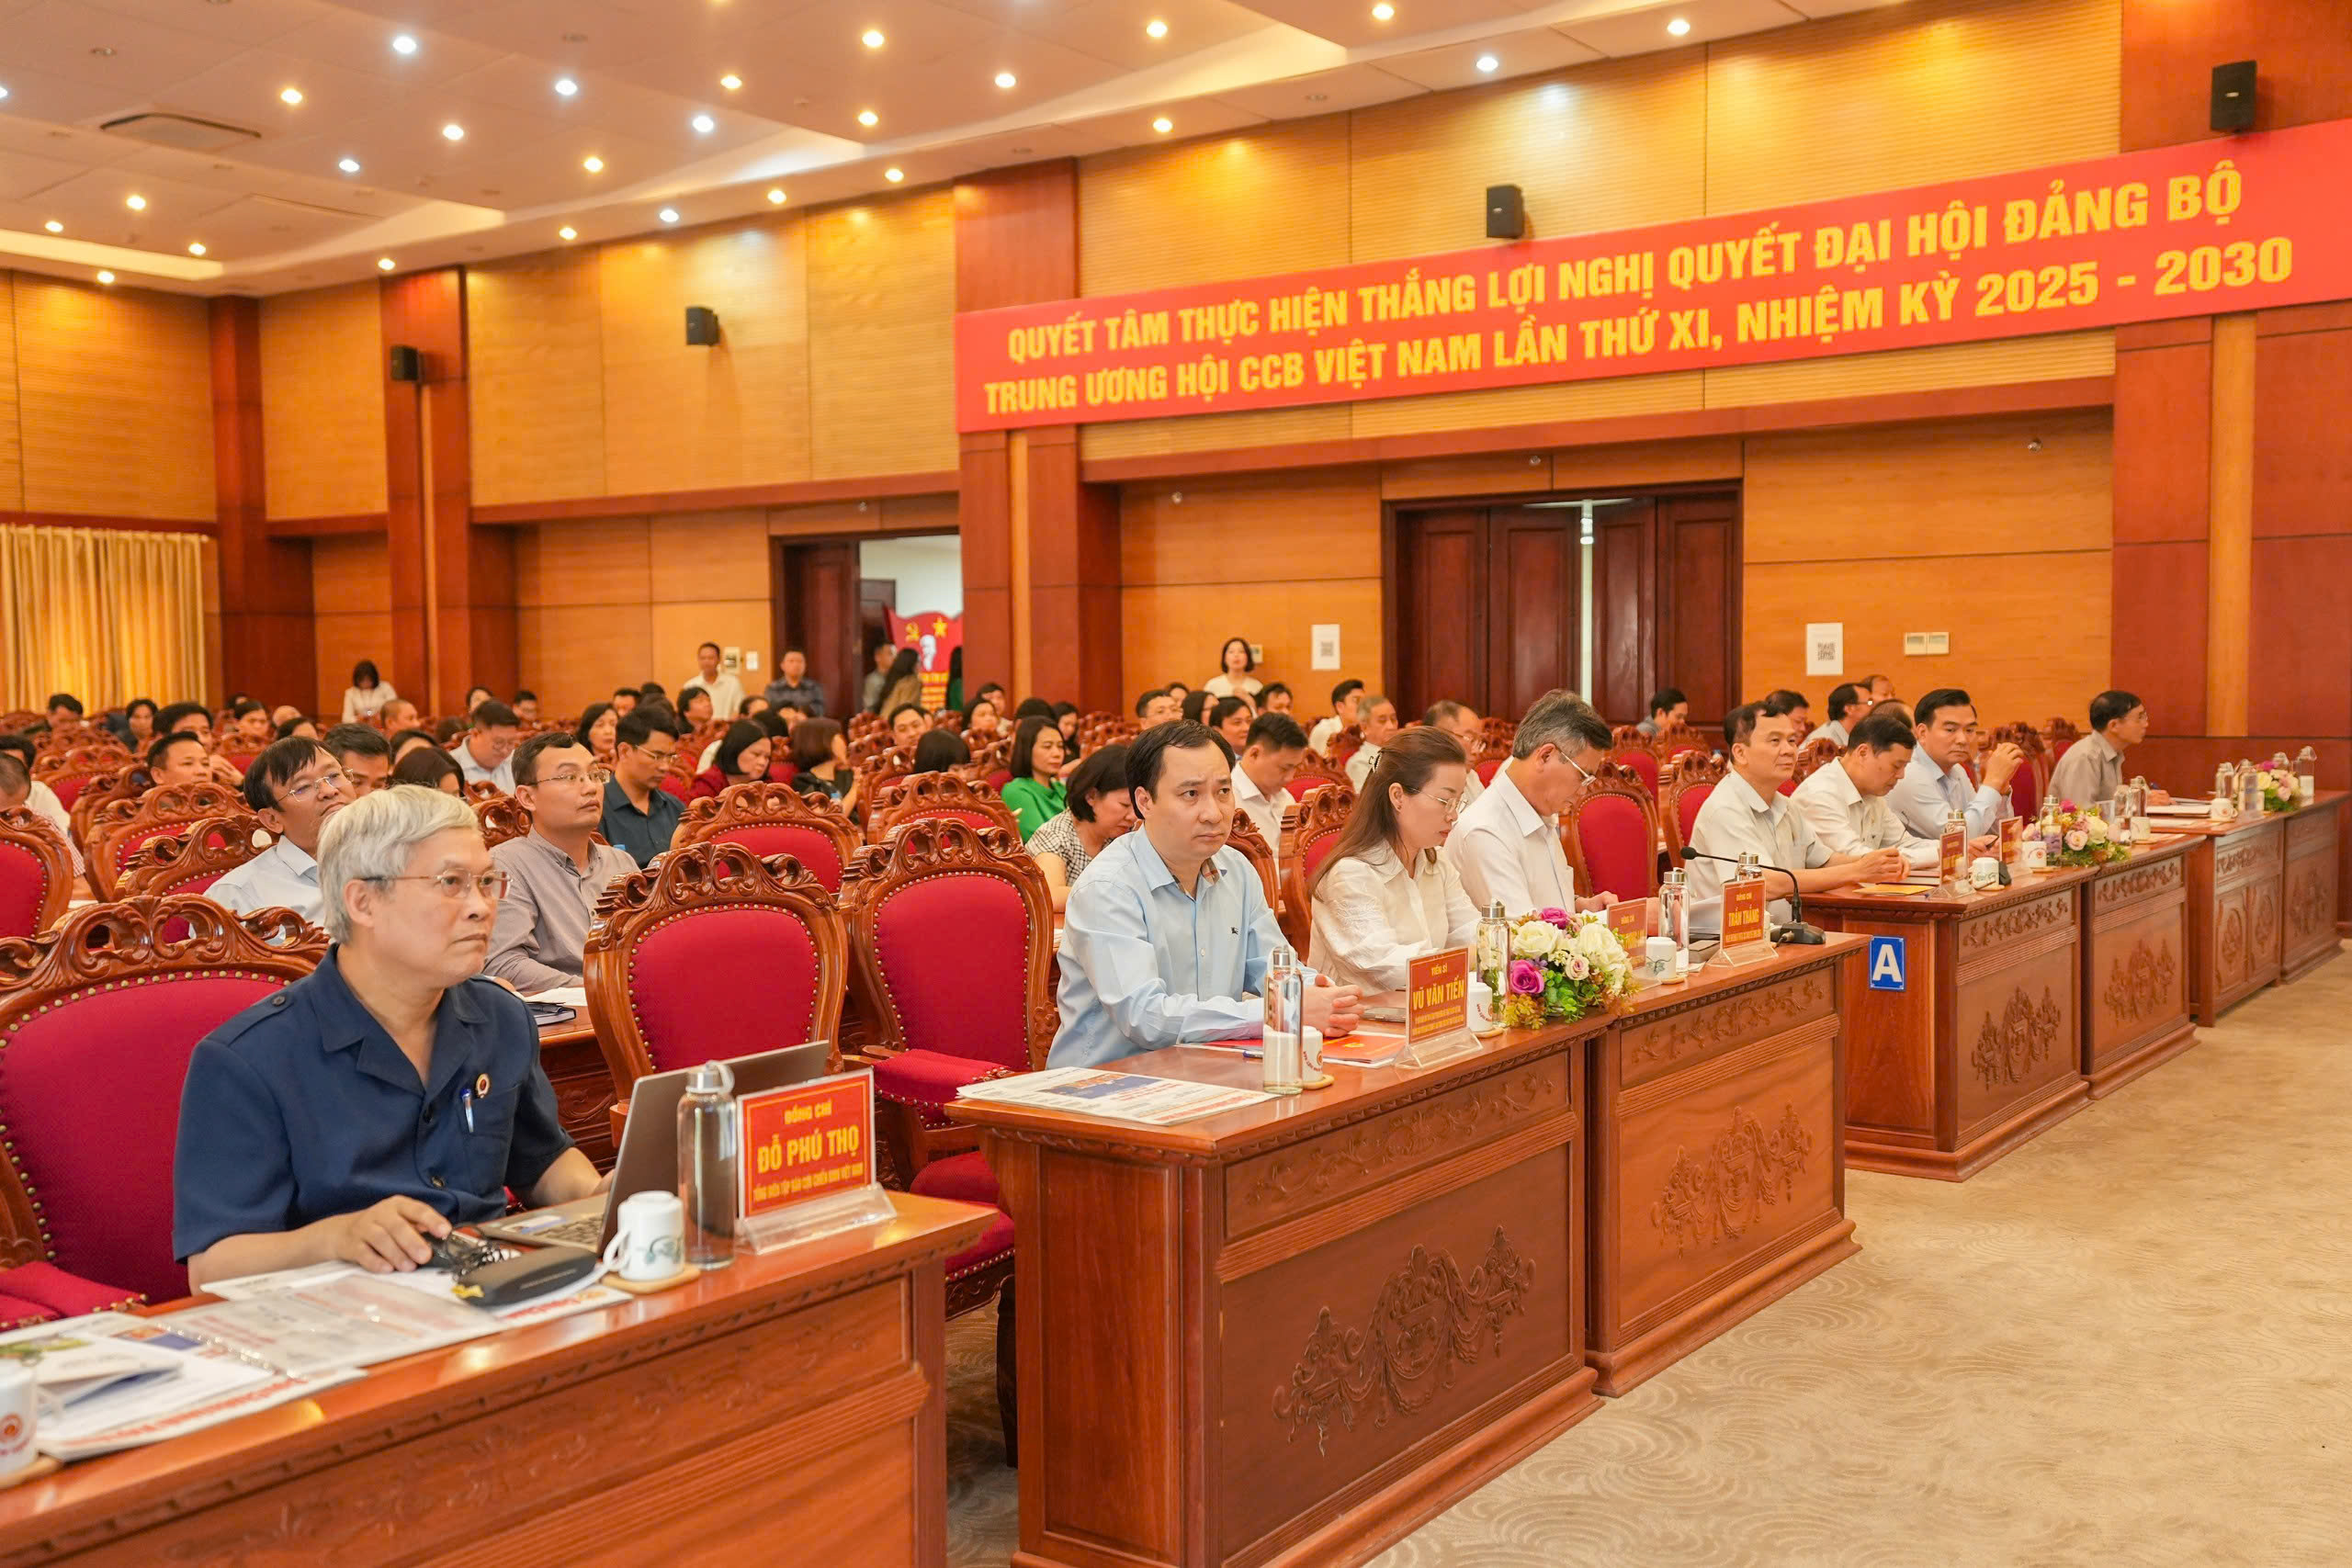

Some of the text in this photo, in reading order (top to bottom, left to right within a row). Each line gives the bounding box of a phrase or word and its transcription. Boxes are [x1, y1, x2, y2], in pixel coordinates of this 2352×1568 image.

[1008, 159, 2242, 365] QUYẾT TÂM THỰC HIỆN THẮNG LỢI NGHỊ QUYẾT ĐẠI HỘI ĐẢNG BỘ
[985, 375, 1077, 414] TRUNG
[1085, 366, 1168, 404] ƯƠNG
[1177, 354, 1229, 402] HỘI
[1239, 353, 1305, 391] CCB
[1316, 338, 1386, 389] VIỆT
[1397, 333, 1481, 377] NAM
[1494, 314, 1567, 367] LẦN
[1579, 307, 1660, 359] THỨ
[1668, 309, 1723, 352] XI,
[1737, 285, 1883, 344] NHIỆM
[1900, 267, 1961, 325] KỲ
[1975, 261, 2099, 316] 2025
[2154, 237, 2293, 295] 2030
[1872, 944, 1903, 983] A
[1413, 976, 1464, 1011] VŨ VĂN TIẾN
[757, 1124, 859, 1175] ĐỖ PHÚ THỌ
